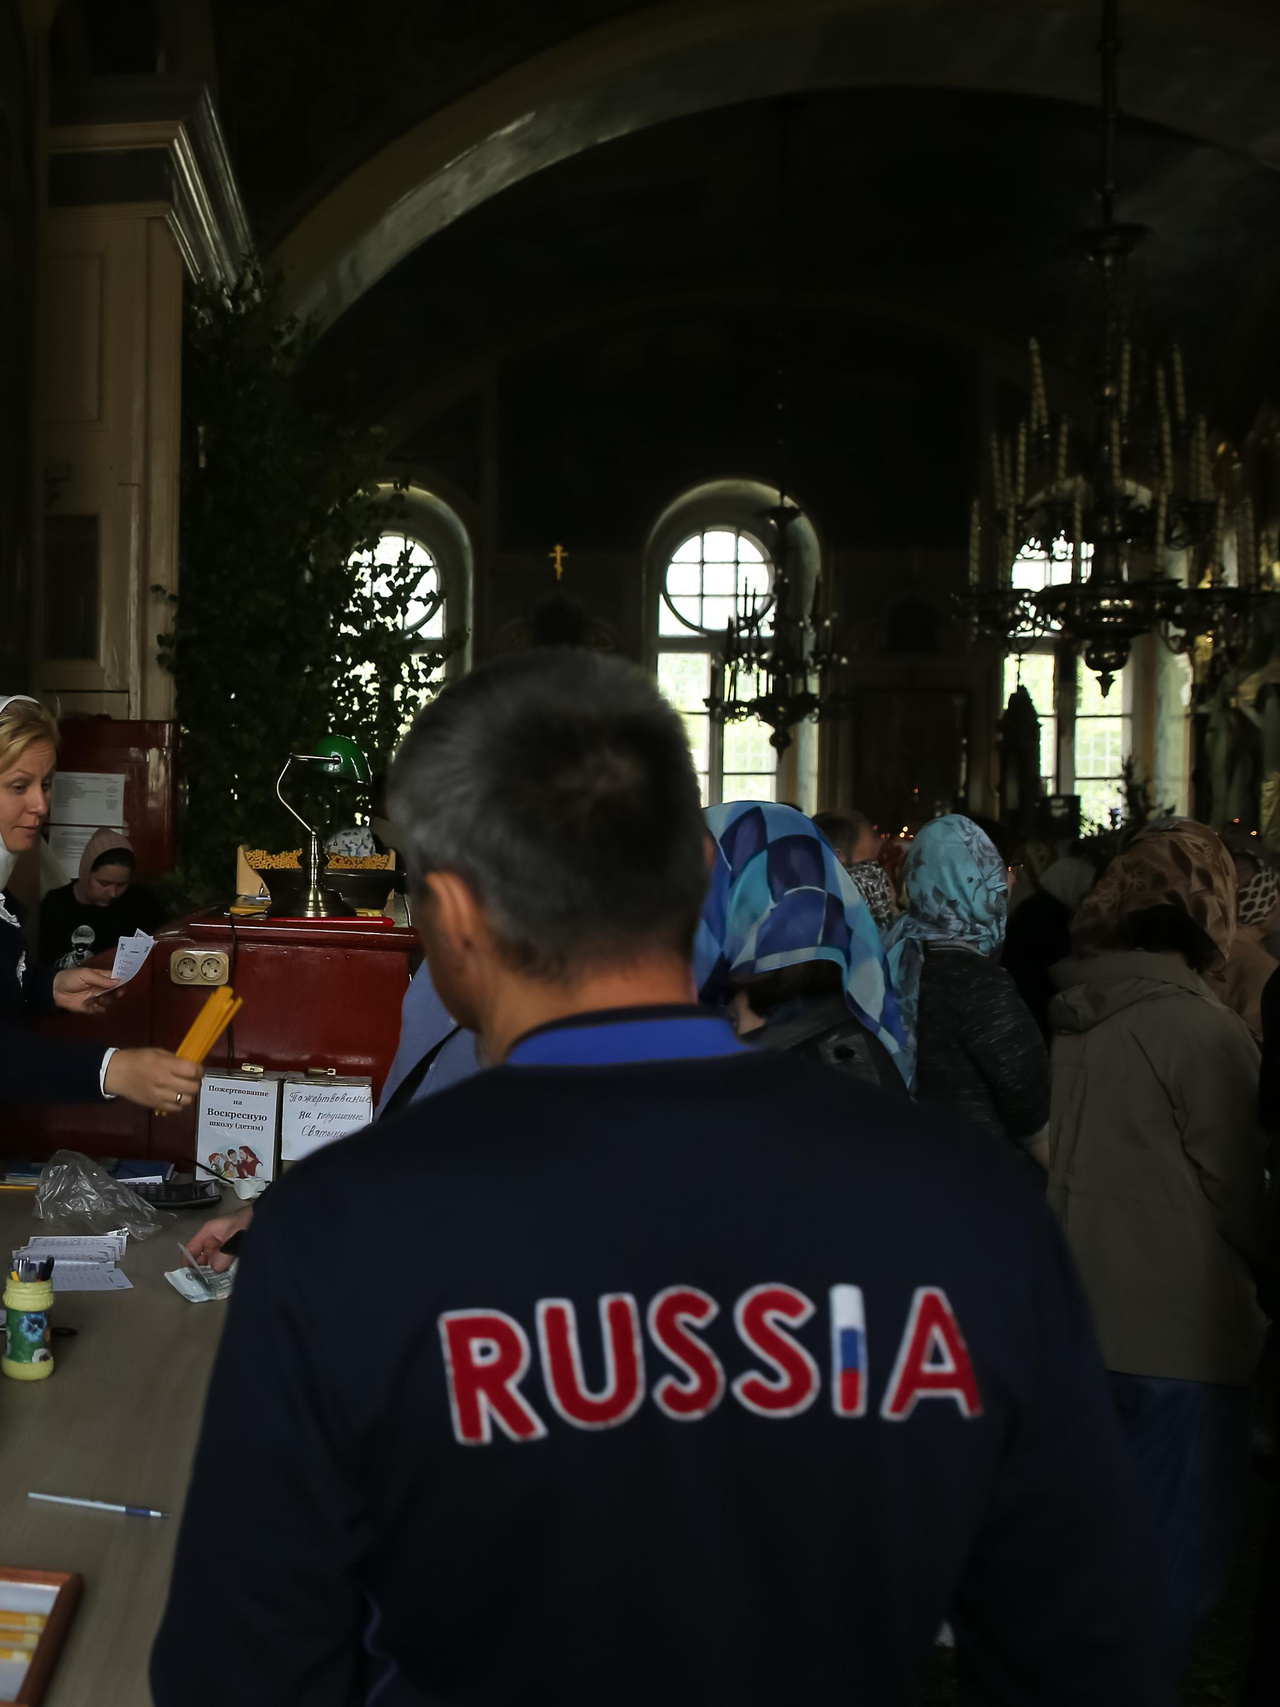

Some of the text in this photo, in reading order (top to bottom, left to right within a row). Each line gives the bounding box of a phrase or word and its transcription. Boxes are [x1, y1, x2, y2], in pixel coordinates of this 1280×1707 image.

[208, 1085, 269, 1097] Пожертвование
[289, 1090, 372, 1106] Пожертвование
[207, 1107, 268, 1122] Воскресную
[209, 1121, 264, 1131] школу (детям)
[438, 1282, 982, 1446] RUSSIA
